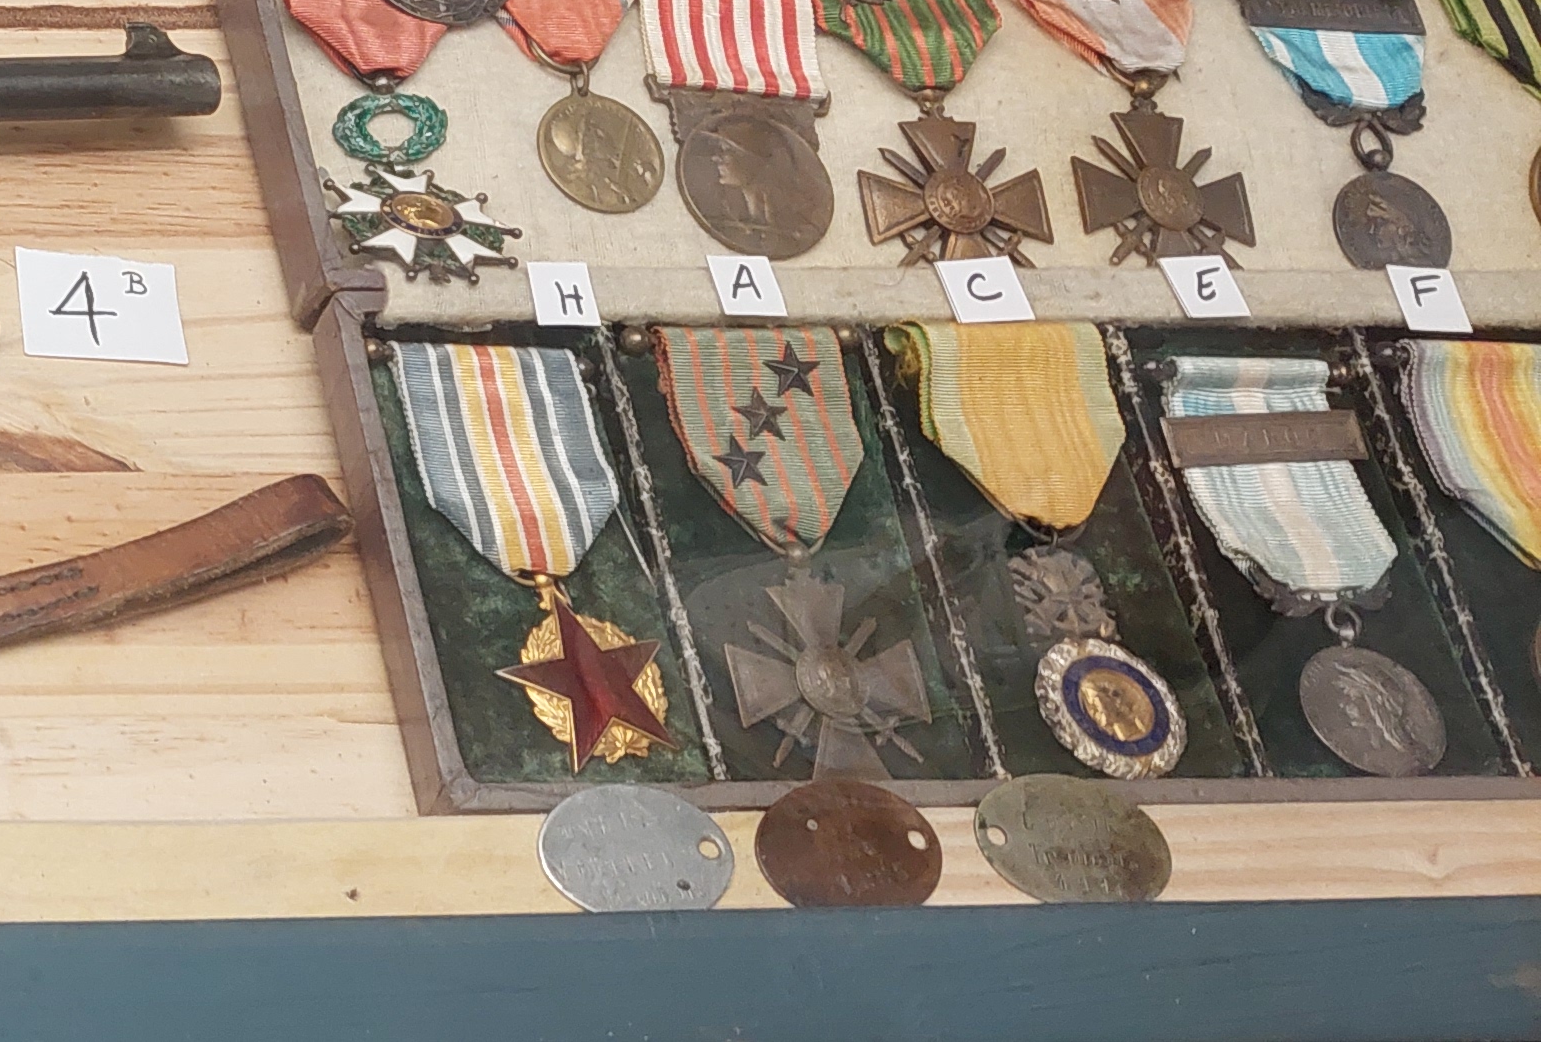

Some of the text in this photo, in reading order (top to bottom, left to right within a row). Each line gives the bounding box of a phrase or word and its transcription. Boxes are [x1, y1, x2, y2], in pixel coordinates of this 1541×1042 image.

[555, 281, 584, 315] H
[732, 264, 762, 299] A
[967, 272, 1003, 301] C
[1195, 267, 1220, 301] E
[1410, 275, 1441, 306] F
